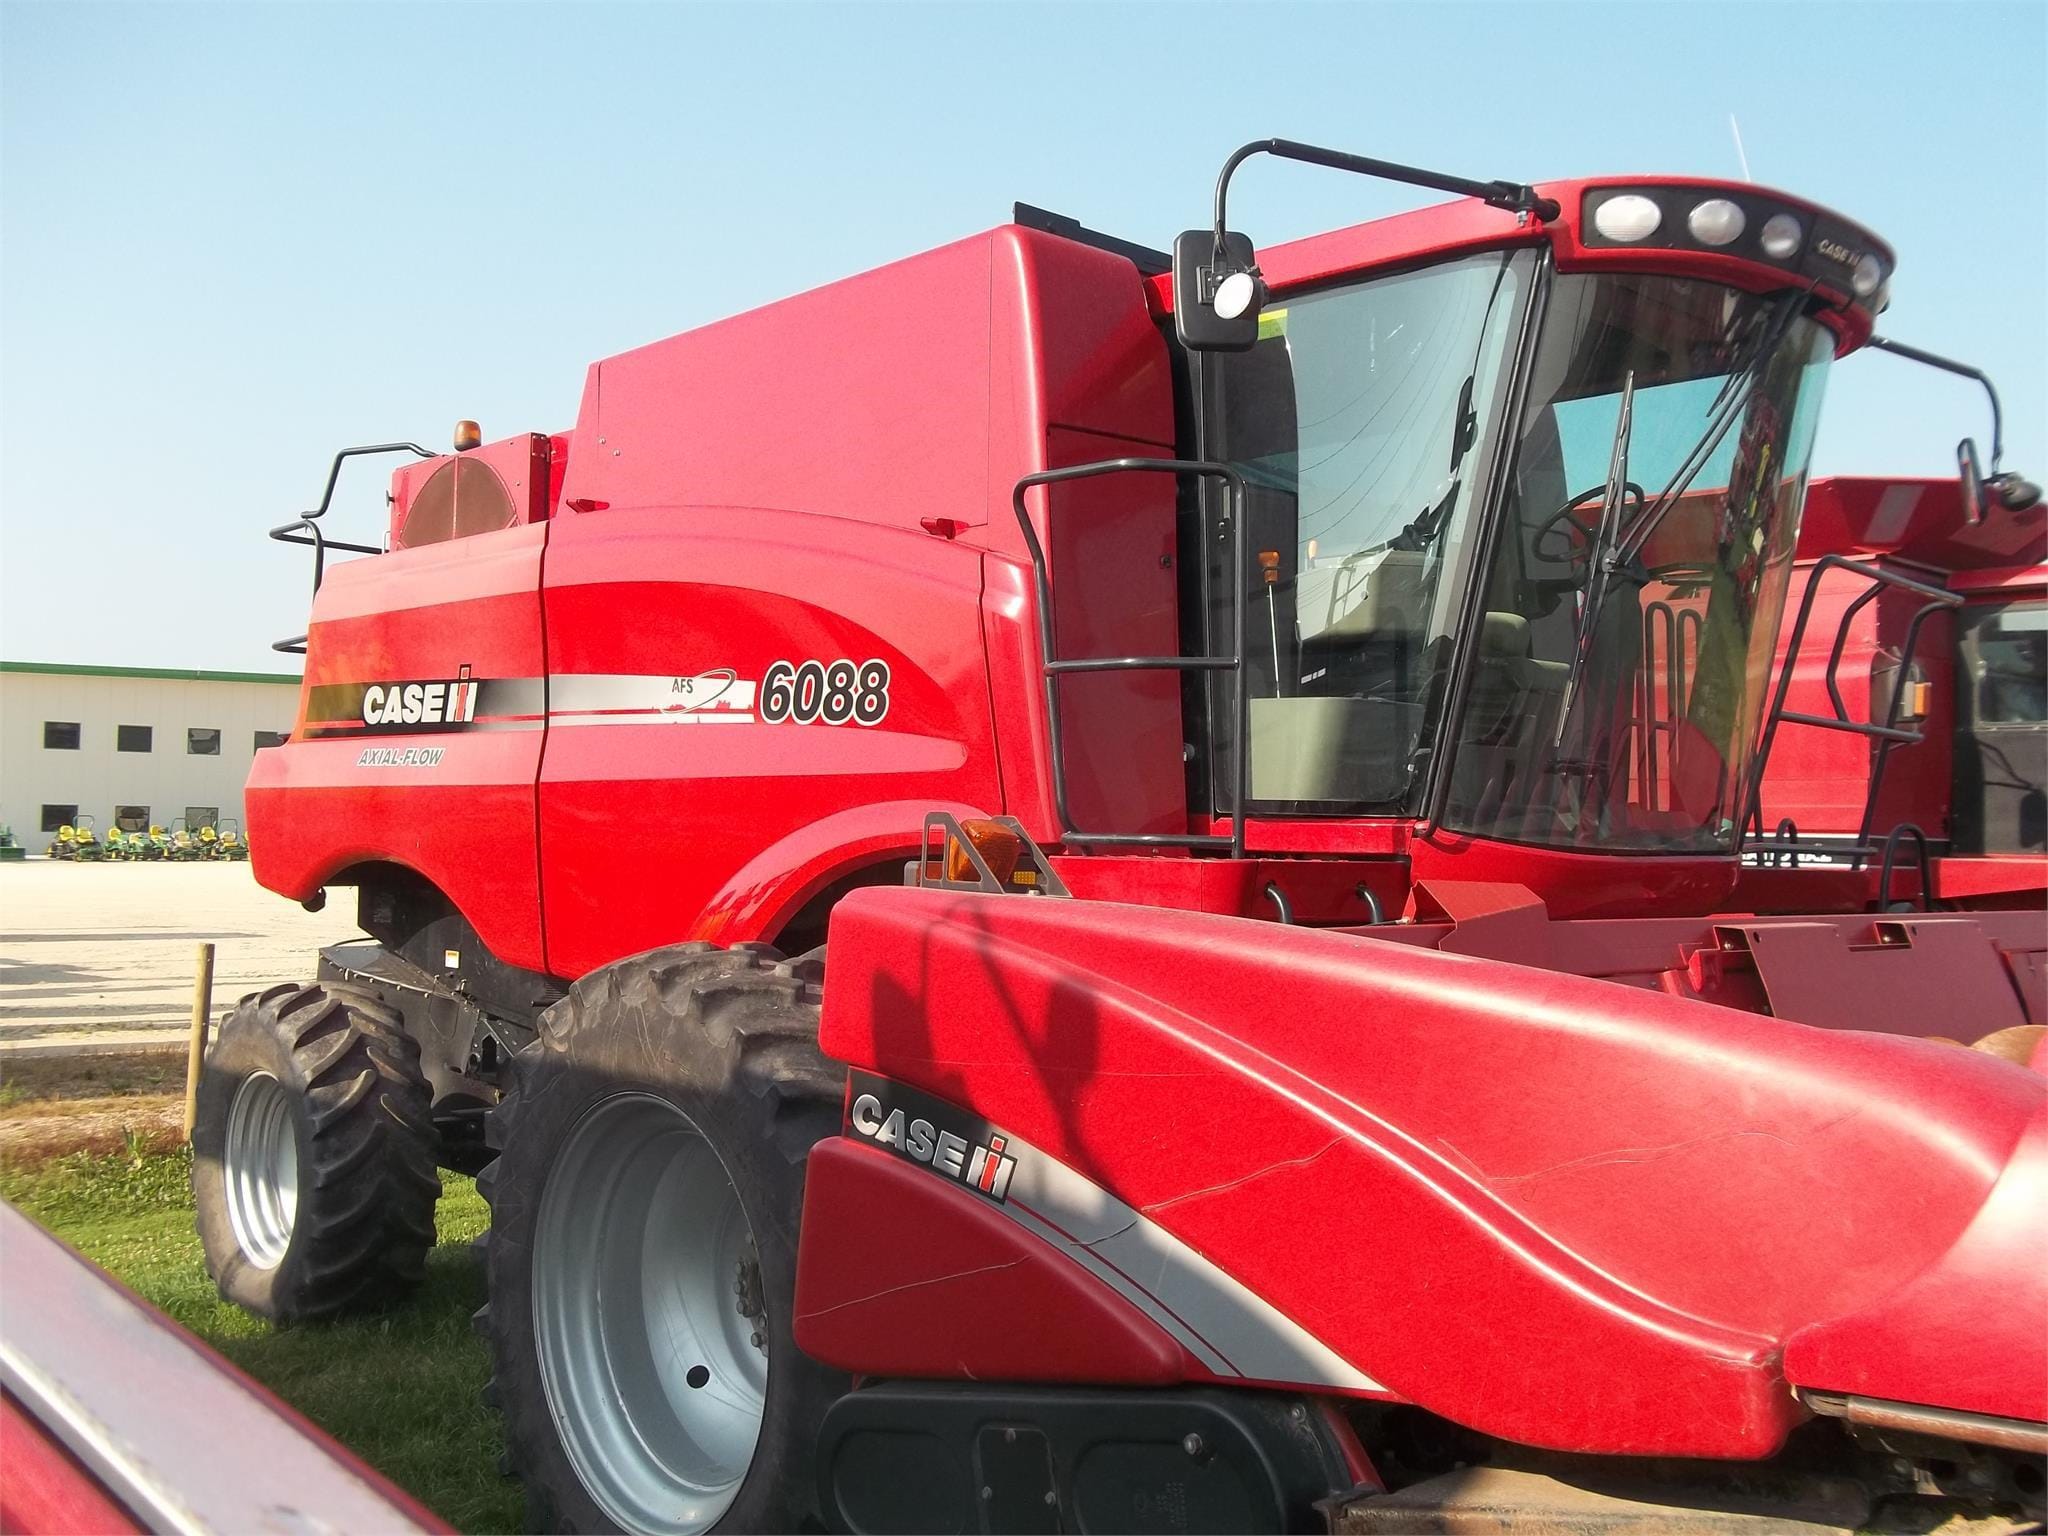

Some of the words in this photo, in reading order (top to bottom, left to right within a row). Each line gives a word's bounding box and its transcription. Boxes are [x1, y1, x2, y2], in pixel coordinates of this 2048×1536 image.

[1819, 239, 1850, 261] CASE
[671, 678, 694, 694] AFS
[760, 658, 890, 727] 6088
[363, 683, 445, 725] CASE
[357, 747, 446, 767] AXIAL-FLOW
[852, 1093, 968, 1178] CASE
